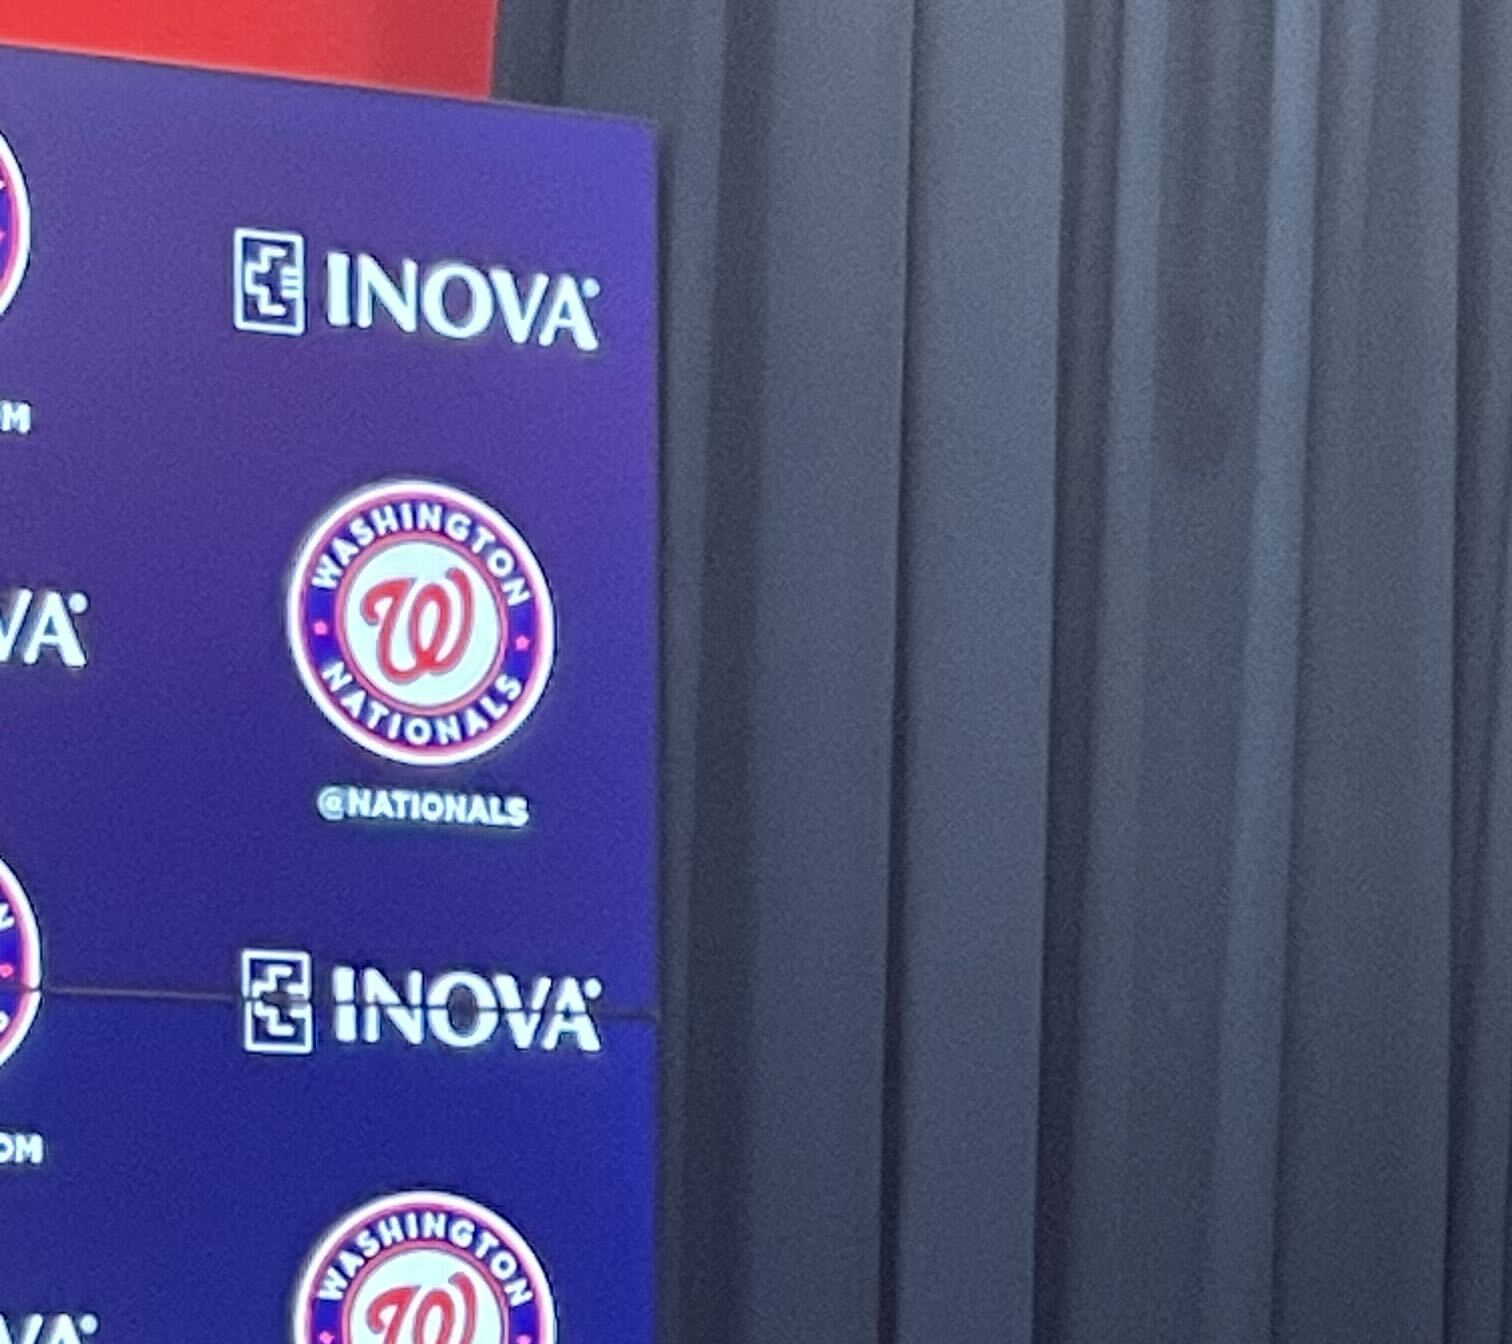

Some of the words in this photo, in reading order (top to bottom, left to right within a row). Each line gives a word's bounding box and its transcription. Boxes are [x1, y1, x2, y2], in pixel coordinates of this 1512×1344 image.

[327, 251, 600, 351] INOVA
[311, 502, 531, 607] WASHINGTON
[322, 662, 524, 746] NATIONALS
[317, 786, 530, 827] @NATIONALS
[333, 966, 601, 1052] INOVA
[317, 1211, 534, 1307] WASHINGTON
